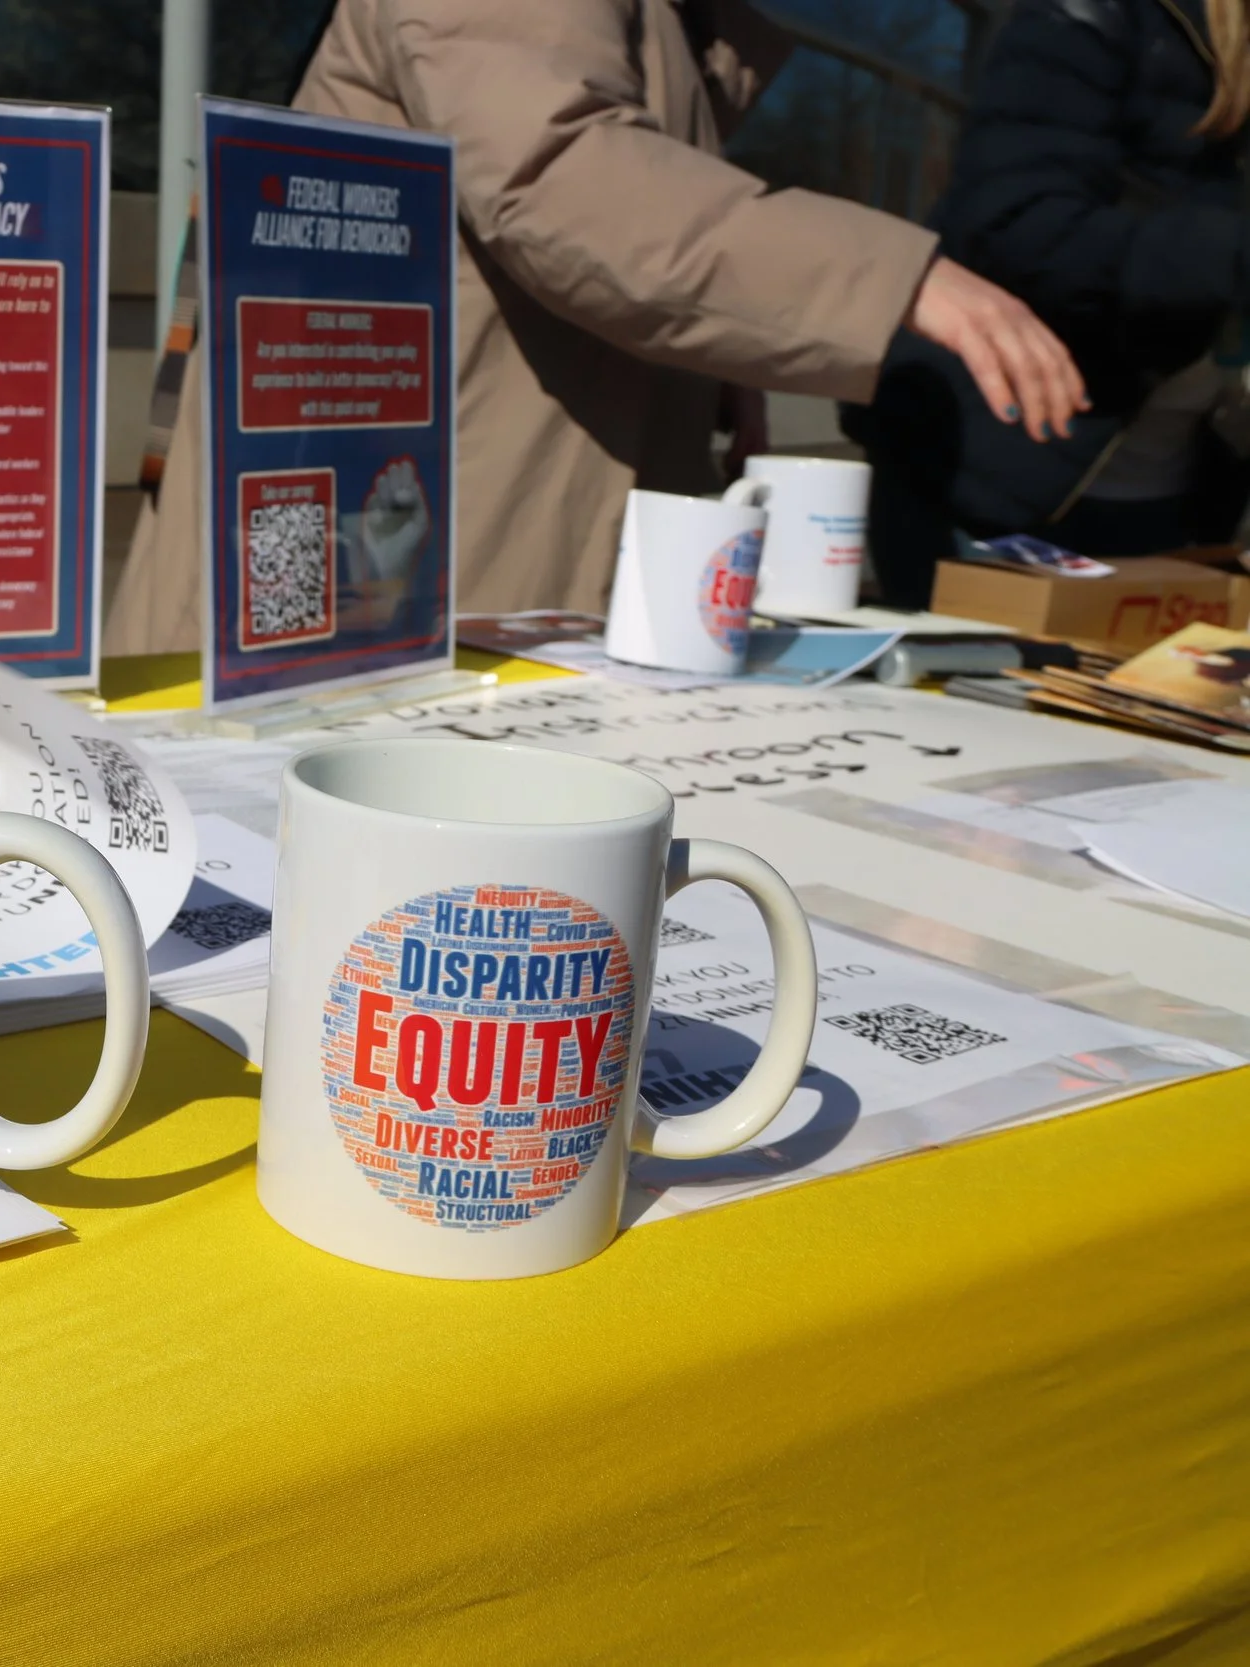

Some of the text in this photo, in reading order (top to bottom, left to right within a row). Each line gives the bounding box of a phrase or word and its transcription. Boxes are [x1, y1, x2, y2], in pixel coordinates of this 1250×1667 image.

[286, 175, 400, 219] FEDERAL WORKERS
[251, 211, 411, 257] ALLIANCE FOR DEMOCRACY
[476, 887, 540, 907] INEQUITY
[435, 900, 531, 940] HEALTH
[547, 923, 588, 942] COVID
[342, 964, 383, 989] ETHNIC
[399, 937, 613, 1001] DISPARITY
[676, 960, 751, 983] YOU
[413, 996, 459, 1012] AMERICAN
[462, 1002, 509, 1017] CULTURAL
[515, 1003, 551, 1016] WOMEN
[561, 998, 613, 1017] POPULATION
[374, 1014, 398, 1030] NEW
[353, 989, 615, 1112] EQUITY
[338, 1086, 371, 1108] SOCIAL
[483, 1110, 535, 1127] RACISM
[540, 1097, 613, 1132] MINORITY
[374, 1111, 495, 1161] DIVERSE
[547, 1131, 593, 1160] BLACK
[354, 1147, 399, 1173] SEXUAL
[510, 1147, 545, 1161] LATINX
[417, 1161, 513, 1199] RACIAL
[531, 1161, 580, 1185] GENDER
[515, 1185, 564, 1200] COMMUNITY
[435, 1200, 532, 1221] STRUCTURAL
